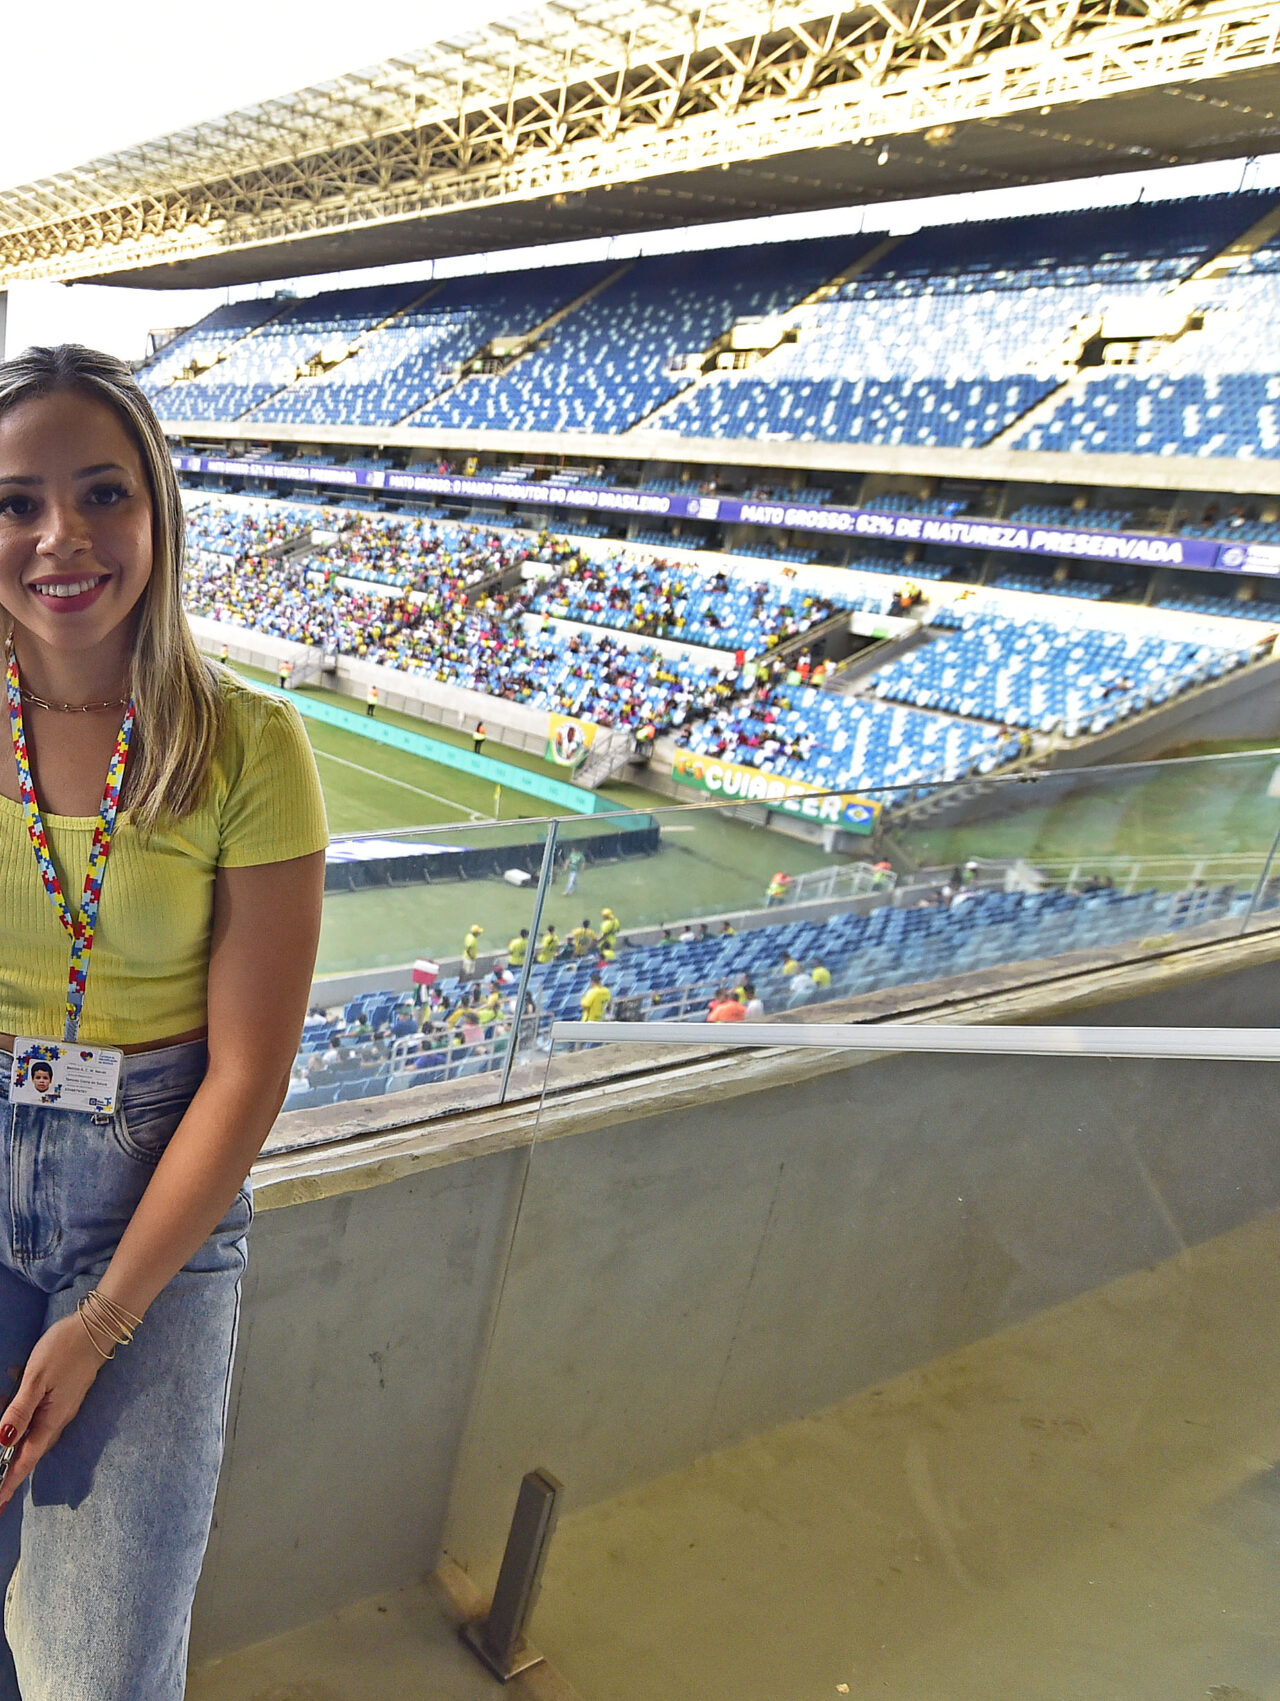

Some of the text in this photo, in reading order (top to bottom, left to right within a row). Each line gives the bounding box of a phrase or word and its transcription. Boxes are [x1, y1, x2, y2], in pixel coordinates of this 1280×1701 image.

[493, 483, 547, 500] PRODUTOR
[549, 488, 565, 503] DO
[566, 490, 596, 506] AGRO
[597, 493, 669, 512] BRASILEIRO
[740, 504, 782, 525] MATO
[783, 508, 854, 531] GROSSO:
[855, 514, 892, 536] 62%
[894, 518, 920, 539] DE
[923, 522, 1026, 548] NATUREZA
[1030, 530, 1181, 563] PRESERVADA
